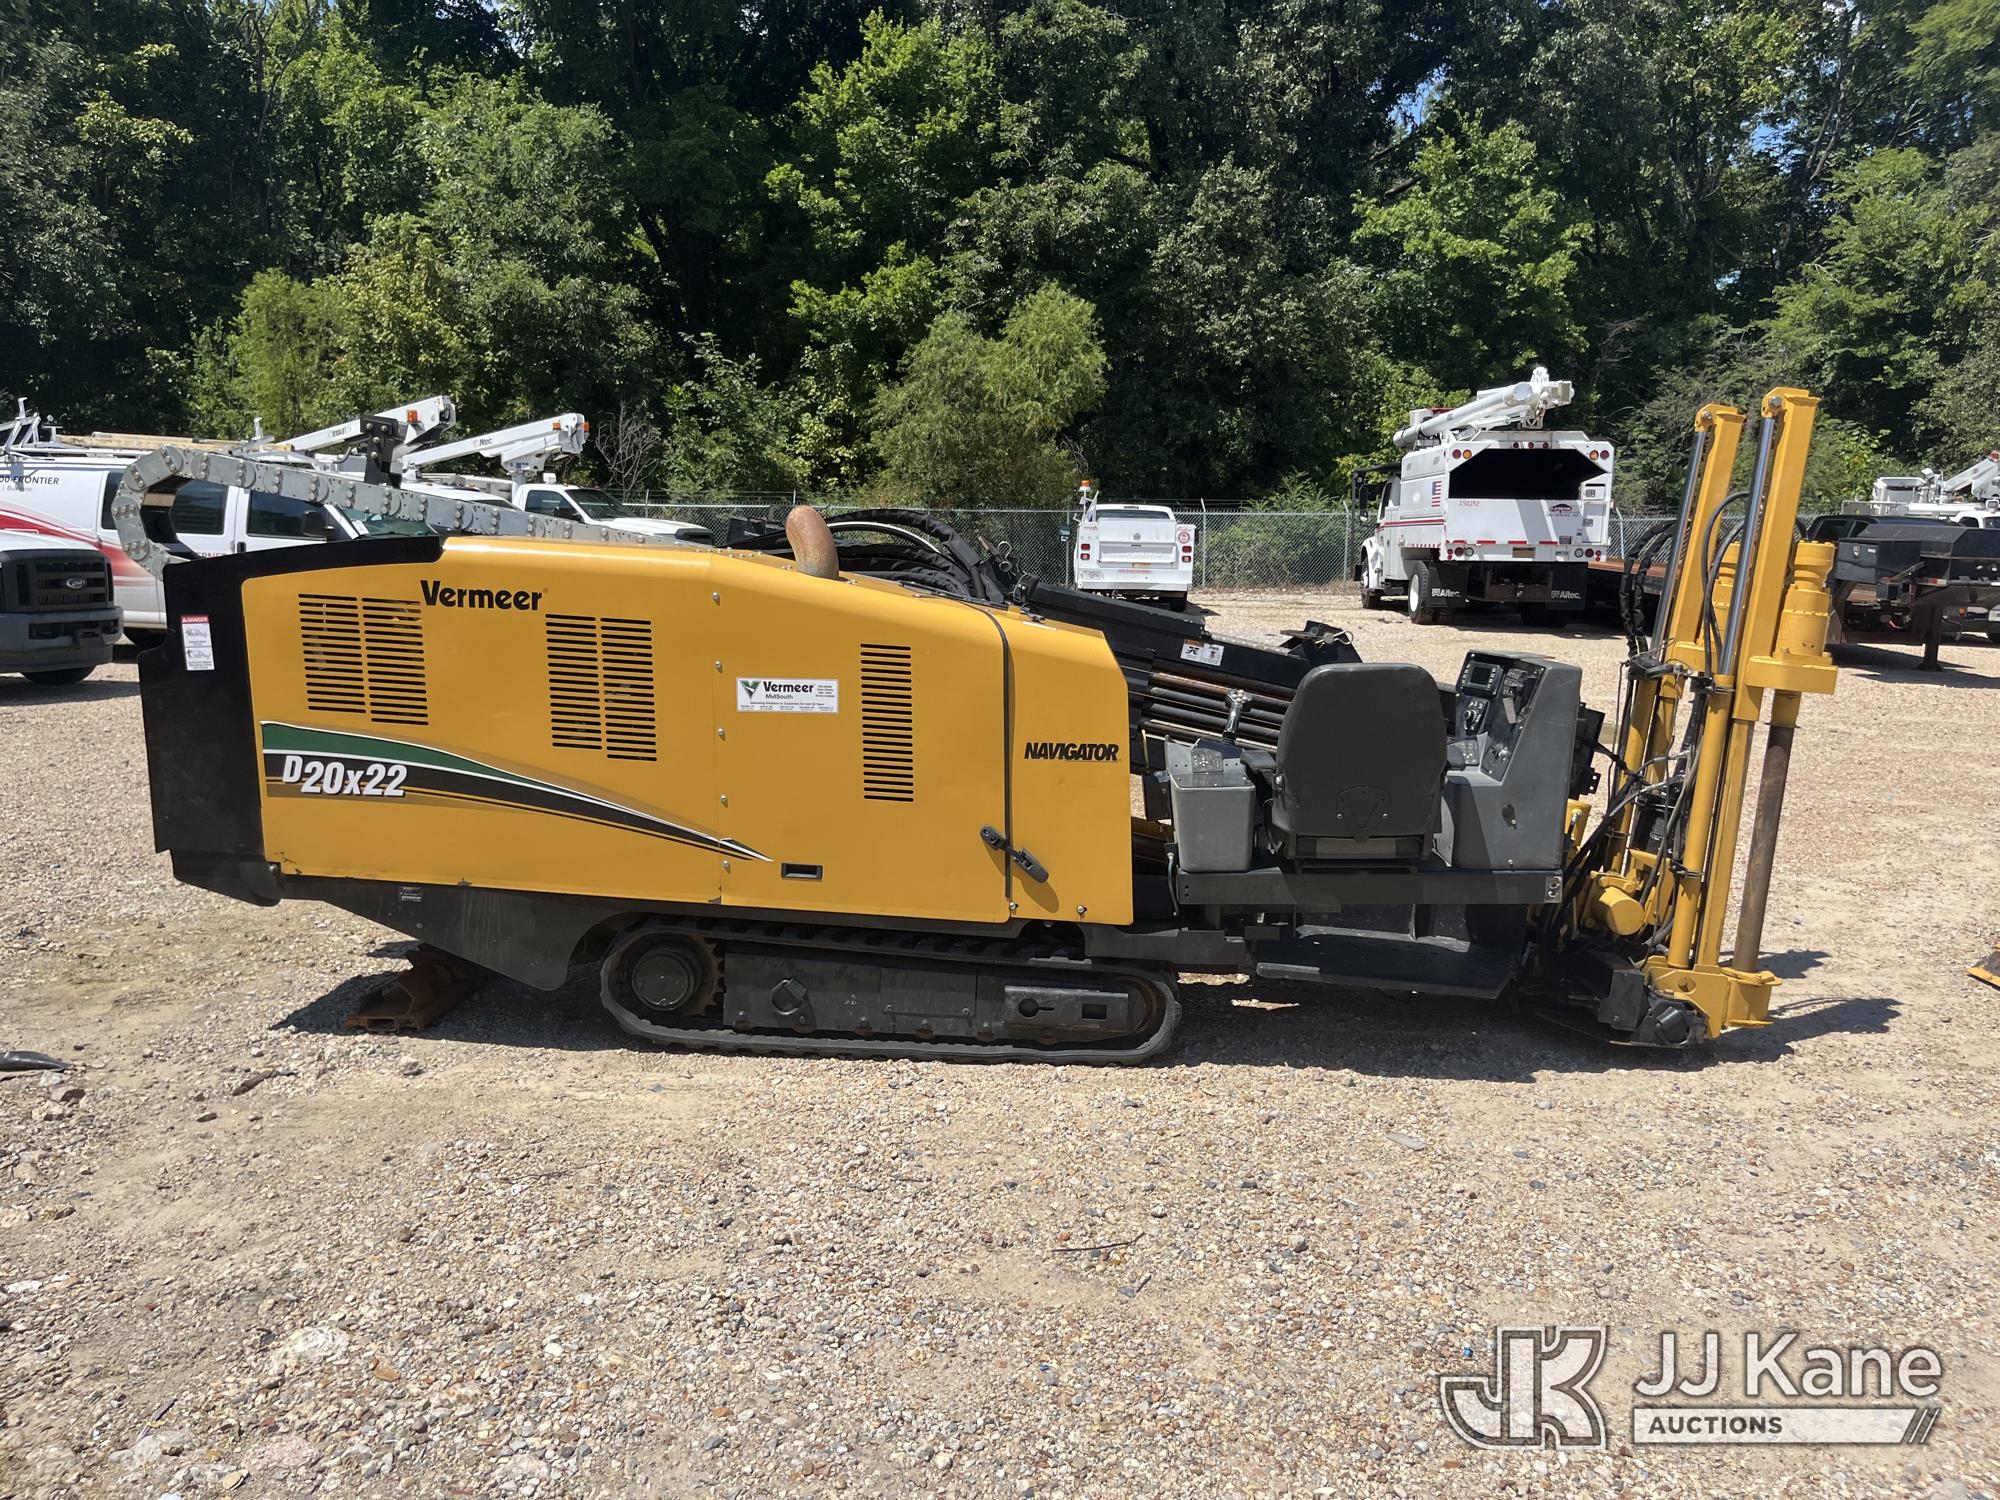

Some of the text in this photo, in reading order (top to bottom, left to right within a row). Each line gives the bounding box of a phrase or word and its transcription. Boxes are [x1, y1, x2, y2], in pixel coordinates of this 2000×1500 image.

[420, 580, 543, 610] Vermeer
[1440, 589, 1461, 598] Altec
[1560, 590, 1581, 599] Altec
[763, 681, 814, 693] Vermeer
[1024, 742, 1119, 761] NAVIGATOR
[282, 755, 407, 797] D20x22
